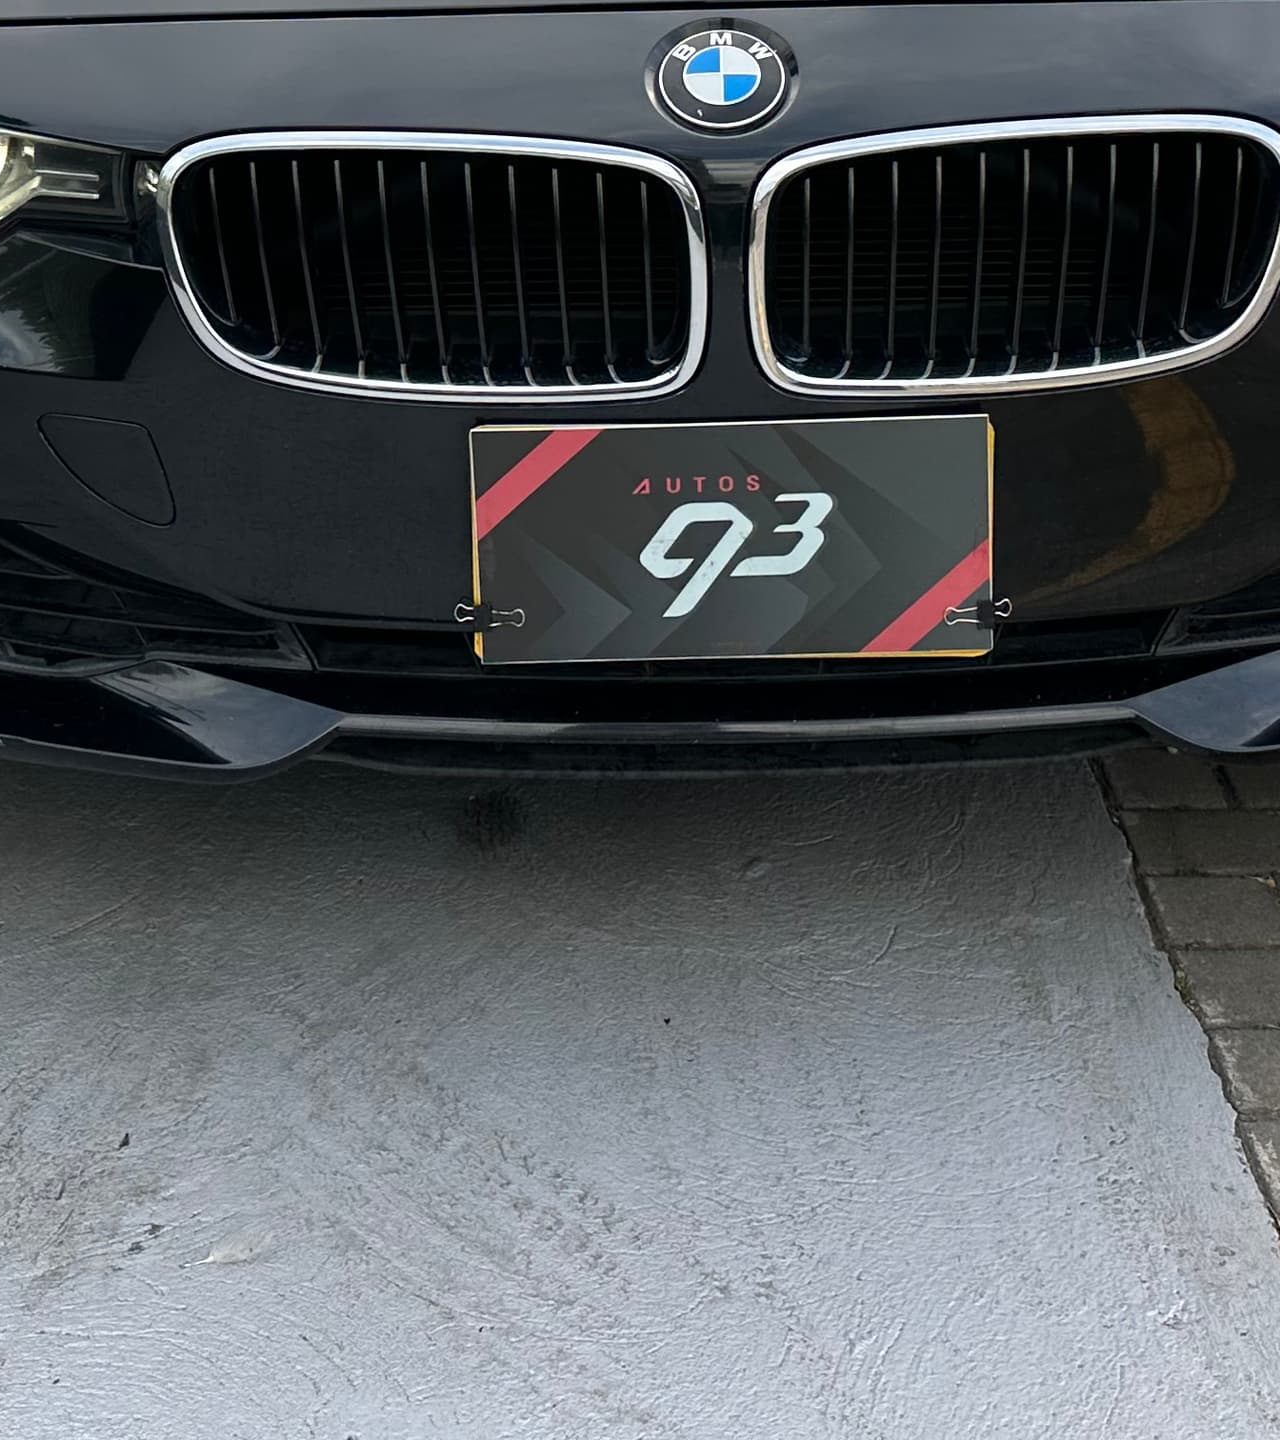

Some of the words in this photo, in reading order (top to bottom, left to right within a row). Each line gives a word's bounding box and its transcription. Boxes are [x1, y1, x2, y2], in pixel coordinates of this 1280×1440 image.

[671, 32, 773, 62] BMW
[632, 474, 762, 496] AUTOS
[639, 491, 834, 619] 93
